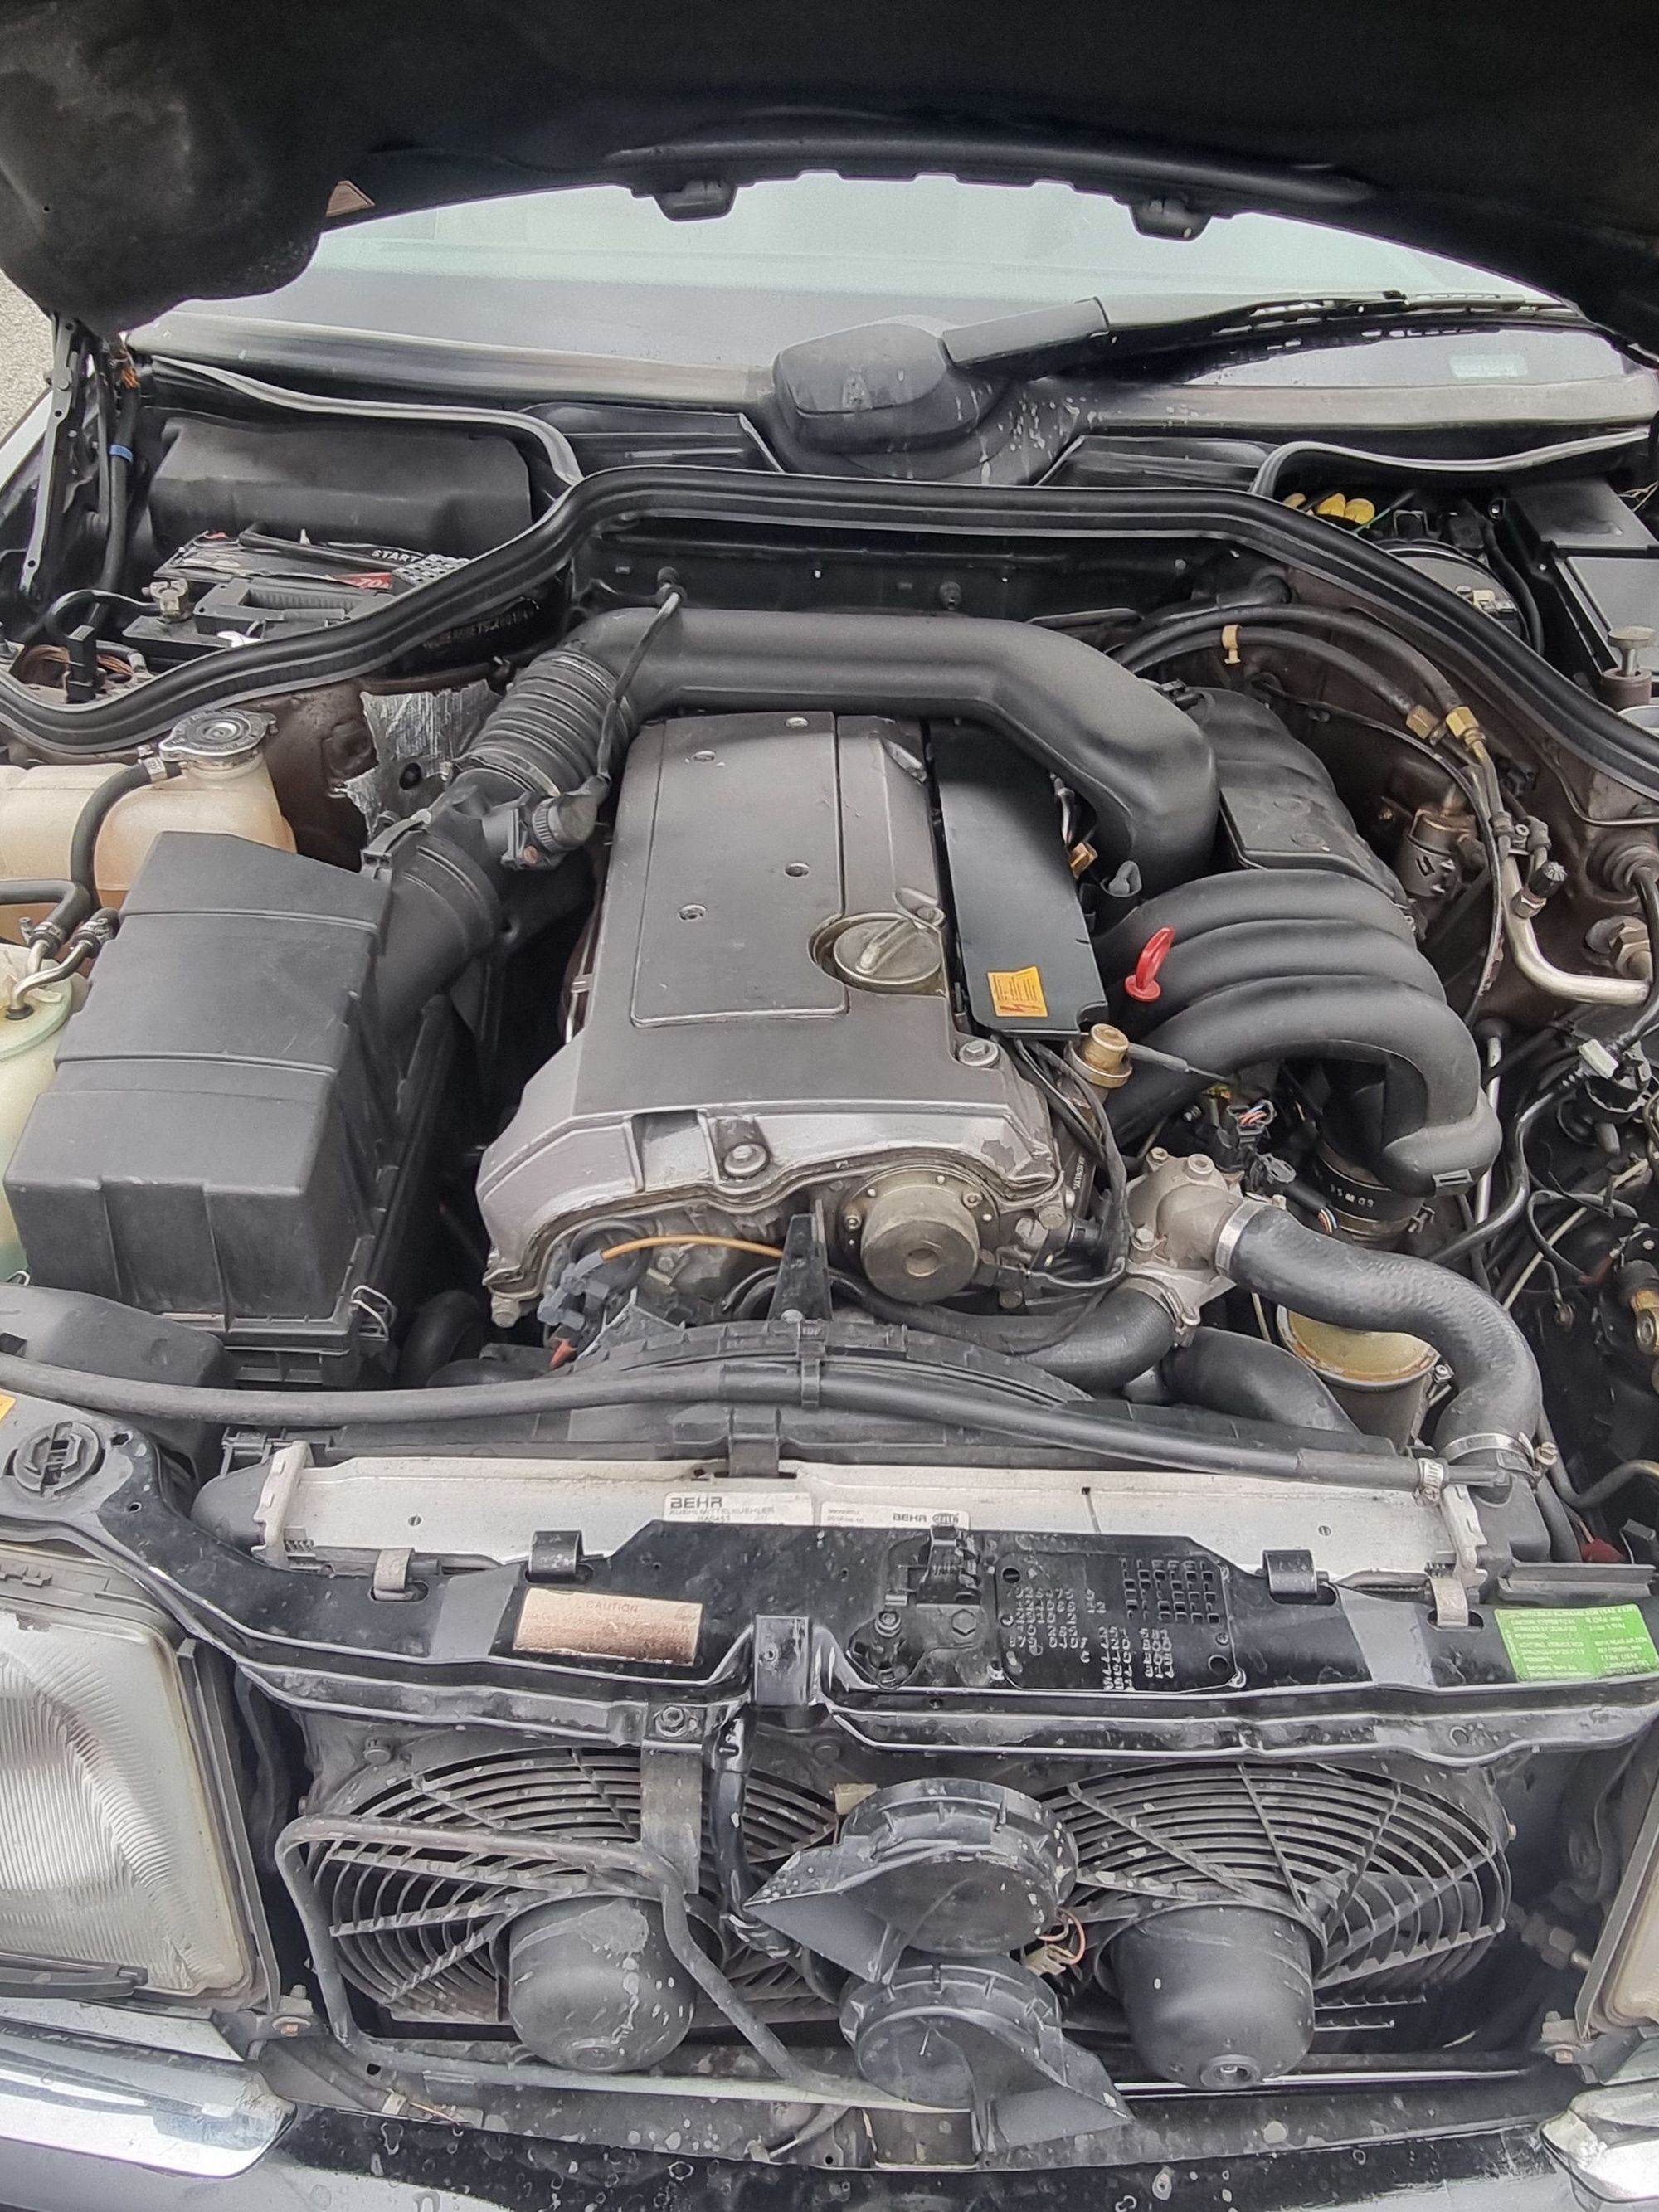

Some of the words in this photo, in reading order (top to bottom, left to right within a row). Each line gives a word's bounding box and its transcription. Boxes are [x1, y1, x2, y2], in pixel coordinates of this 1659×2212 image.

[372, 549, 421, 563] START
[670, 1496, 723, 1509] BEHR
[892, 1512, 927, 1523] BEHR
[586, 1600, 638, 1613] CAUTION
